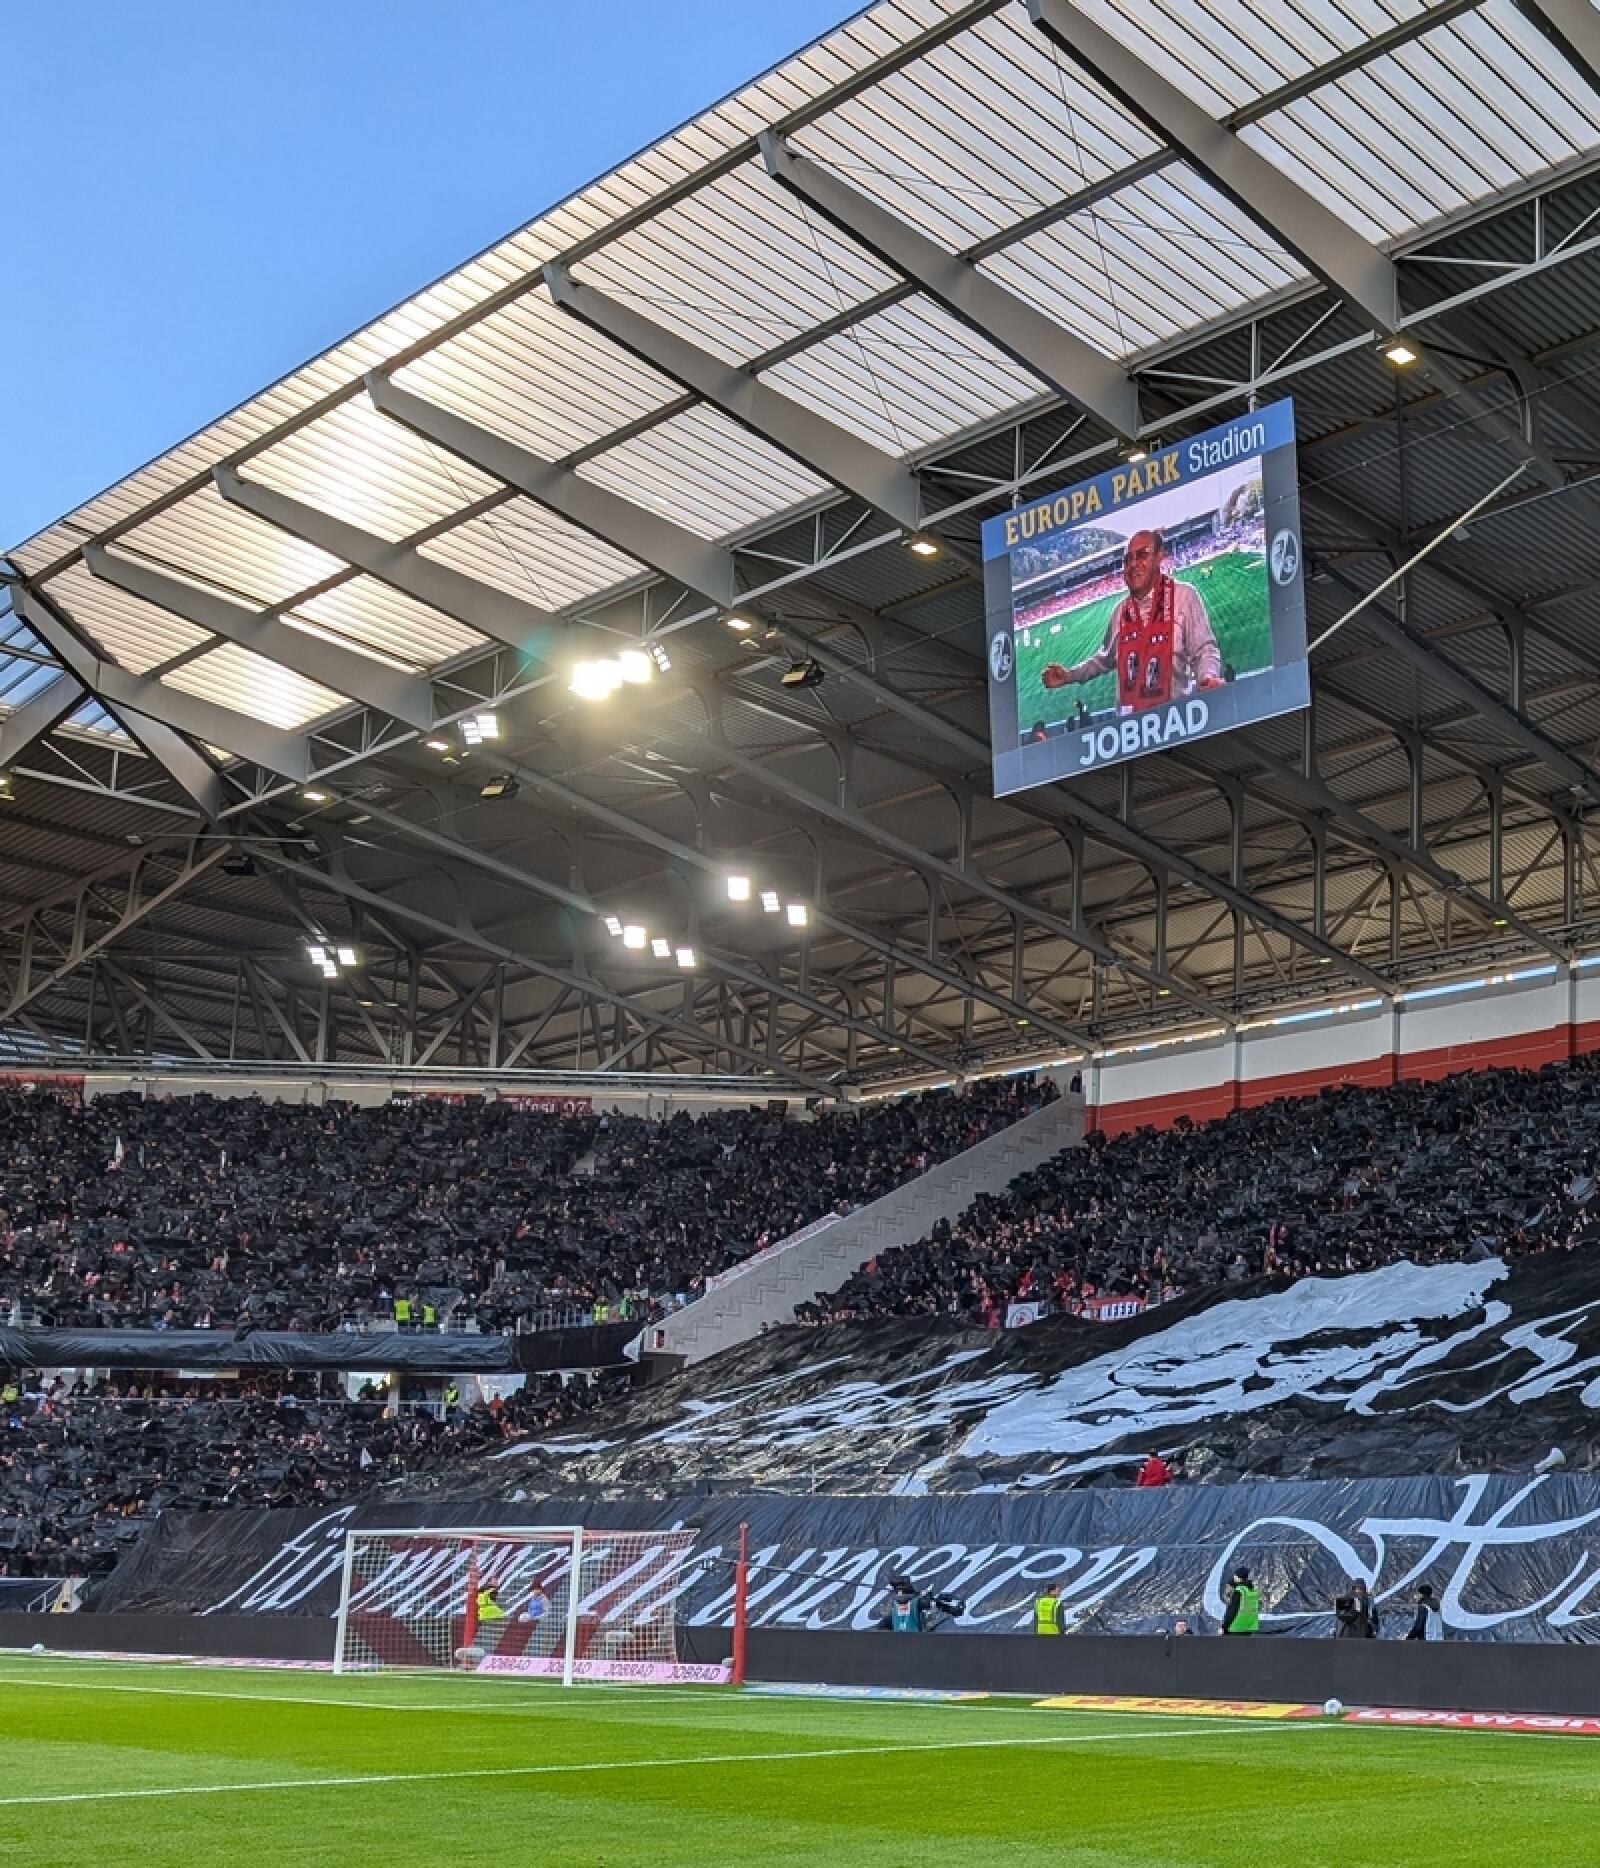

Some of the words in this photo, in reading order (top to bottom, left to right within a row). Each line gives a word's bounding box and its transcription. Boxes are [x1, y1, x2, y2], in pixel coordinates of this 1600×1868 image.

[1005, 485, 1103, 545] EUROPA
[1111, 451, 1181, 504] PARK
[1188, 422, 1265, 473] Stadion
[1079, 699, 1209, 766] JOBRAD
[688, 1542, 1158, 1630] unseren
[543, 1660, 593, 1675] JOBAD
